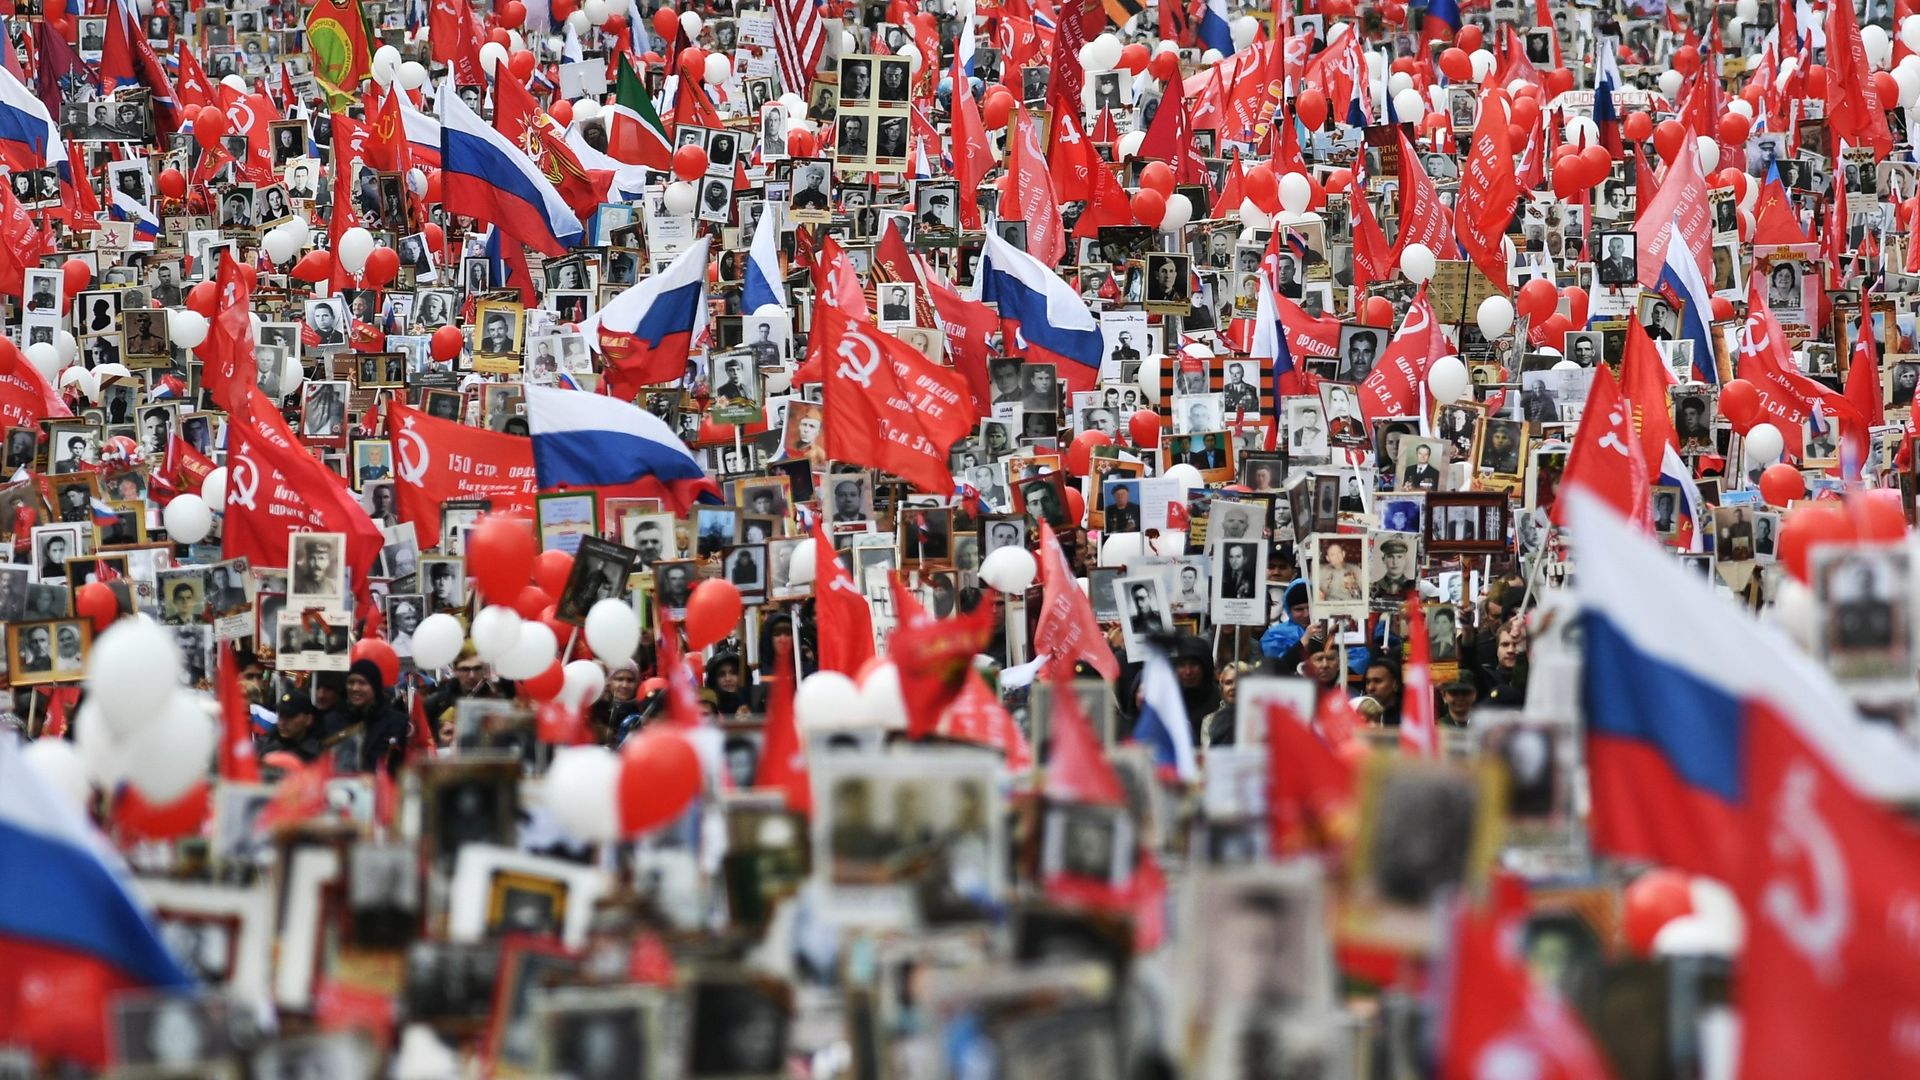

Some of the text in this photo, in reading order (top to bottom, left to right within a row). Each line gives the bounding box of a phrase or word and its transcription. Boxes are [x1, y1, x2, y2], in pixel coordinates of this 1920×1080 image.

[1477, 134, 1495, 157] 150
[1296, 333, 1337, 356] ОРДЕНА
[915, 374, 960, 405] ОРДЕНА
[1365, 369, 1385, 388] 79
[448, 453, 537, 479] 150 СТР. ОРДЕ
